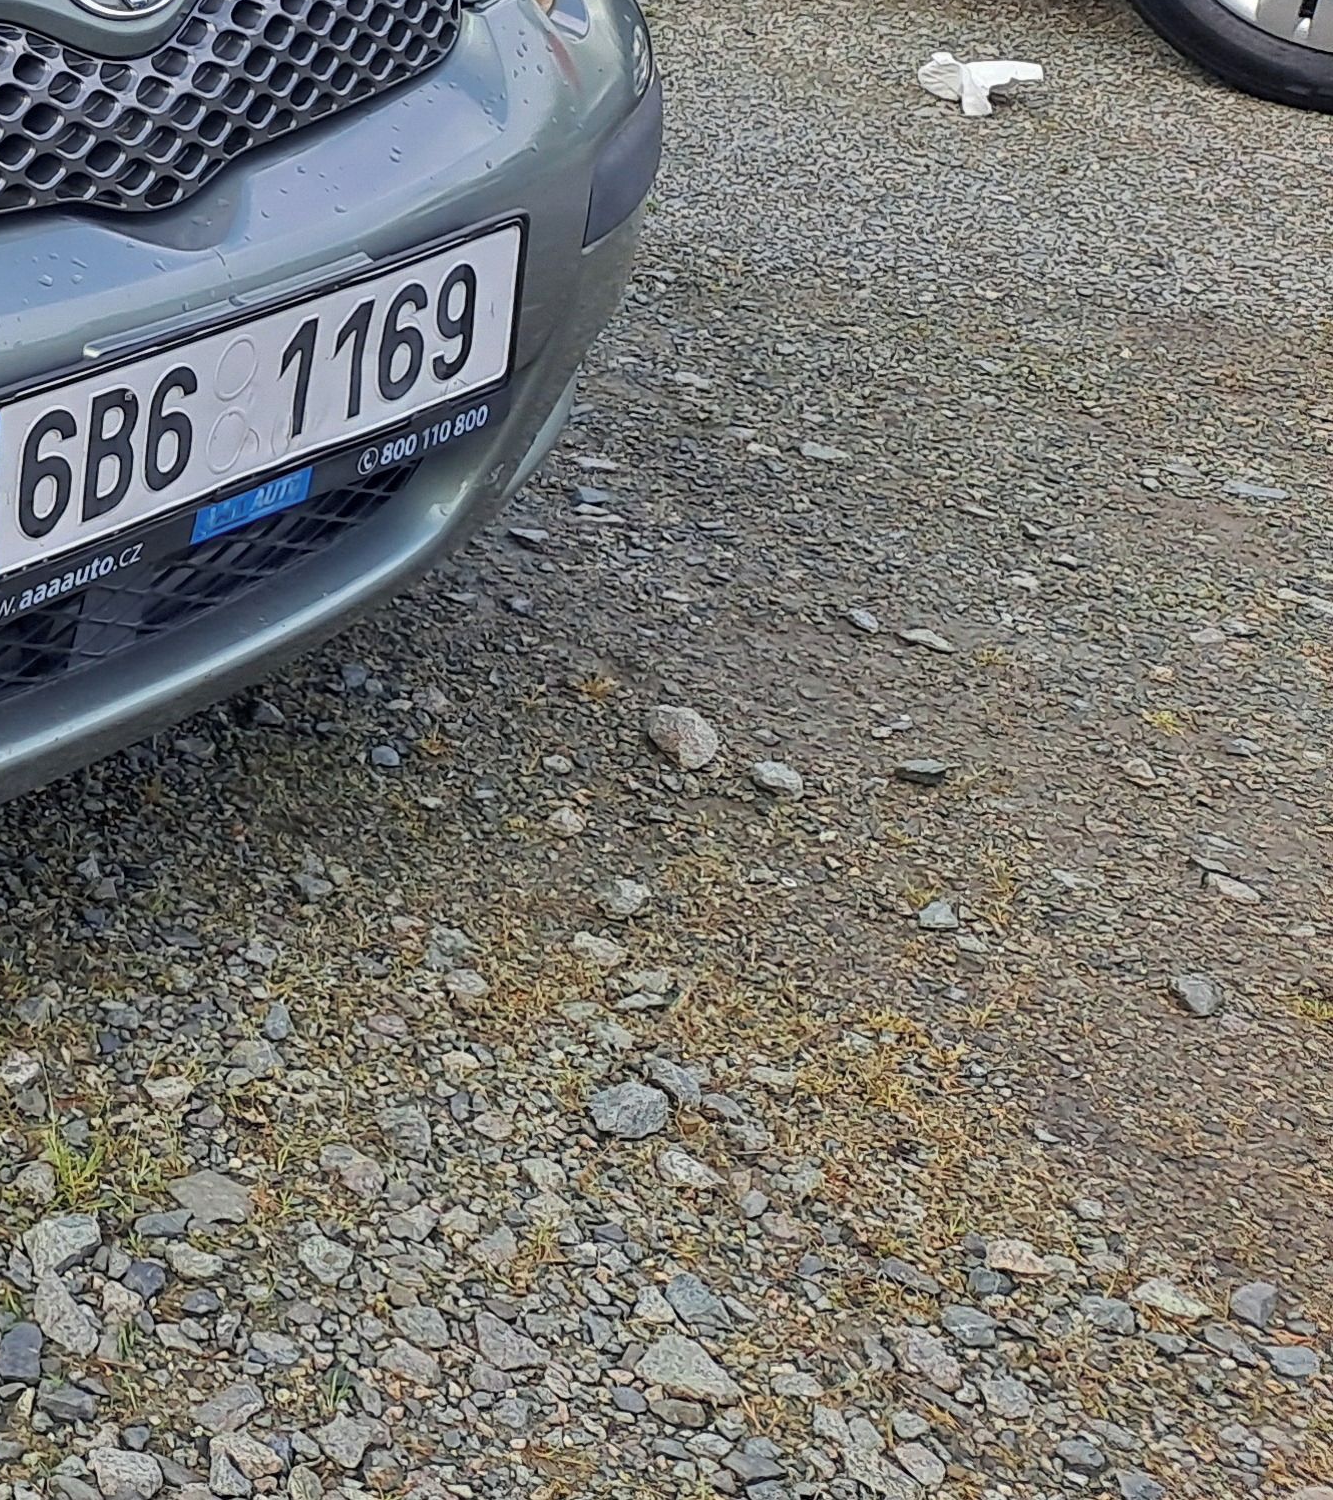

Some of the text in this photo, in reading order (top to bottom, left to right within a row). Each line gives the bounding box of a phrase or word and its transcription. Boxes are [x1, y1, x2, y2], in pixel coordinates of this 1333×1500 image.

[18, 263, 477, 539] 6B6 1169
[380, 404, 489, 466] 800 110 800
